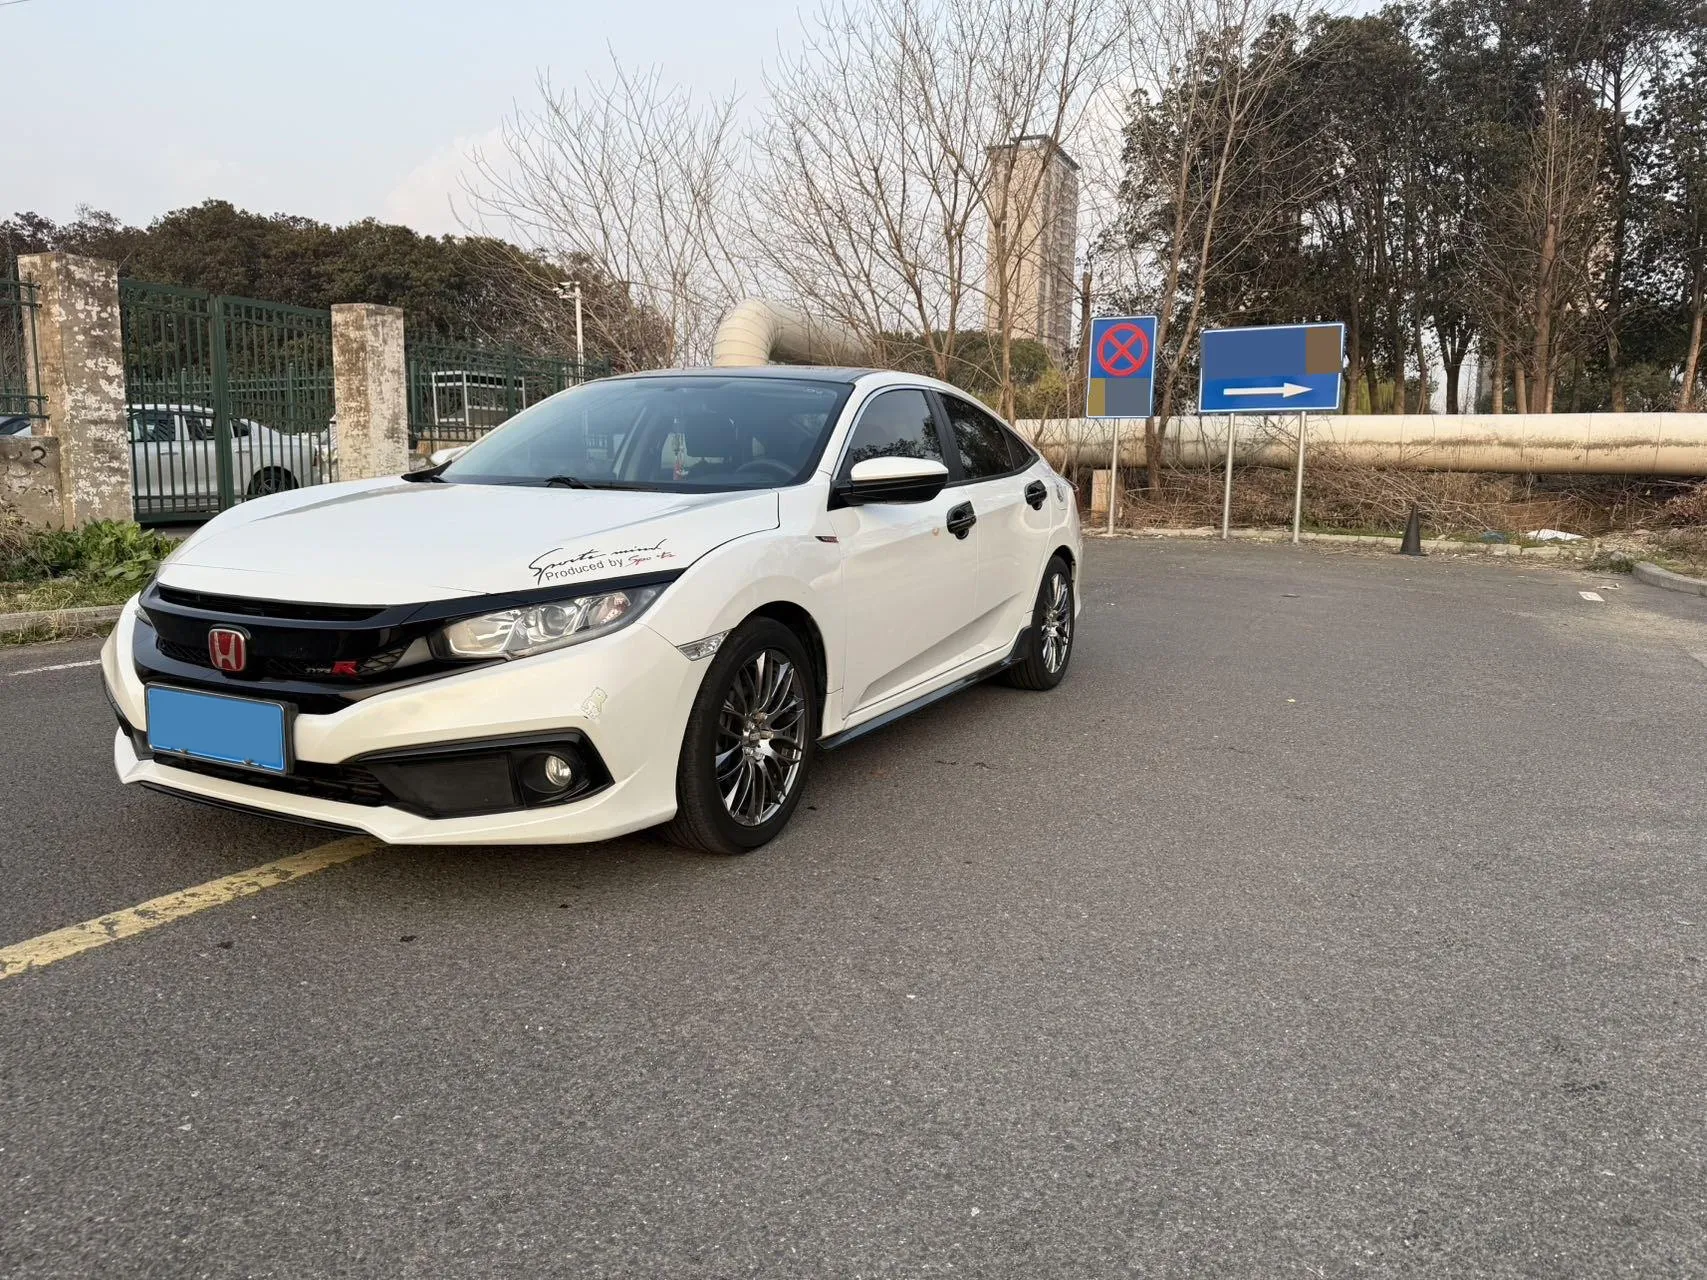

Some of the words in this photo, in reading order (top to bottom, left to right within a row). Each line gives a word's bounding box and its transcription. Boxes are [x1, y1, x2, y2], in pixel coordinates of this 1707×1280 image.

[545, 560, 605, 581] Produced
[609, 558, 623, 568] by
[331, 660, 357, 676] R
